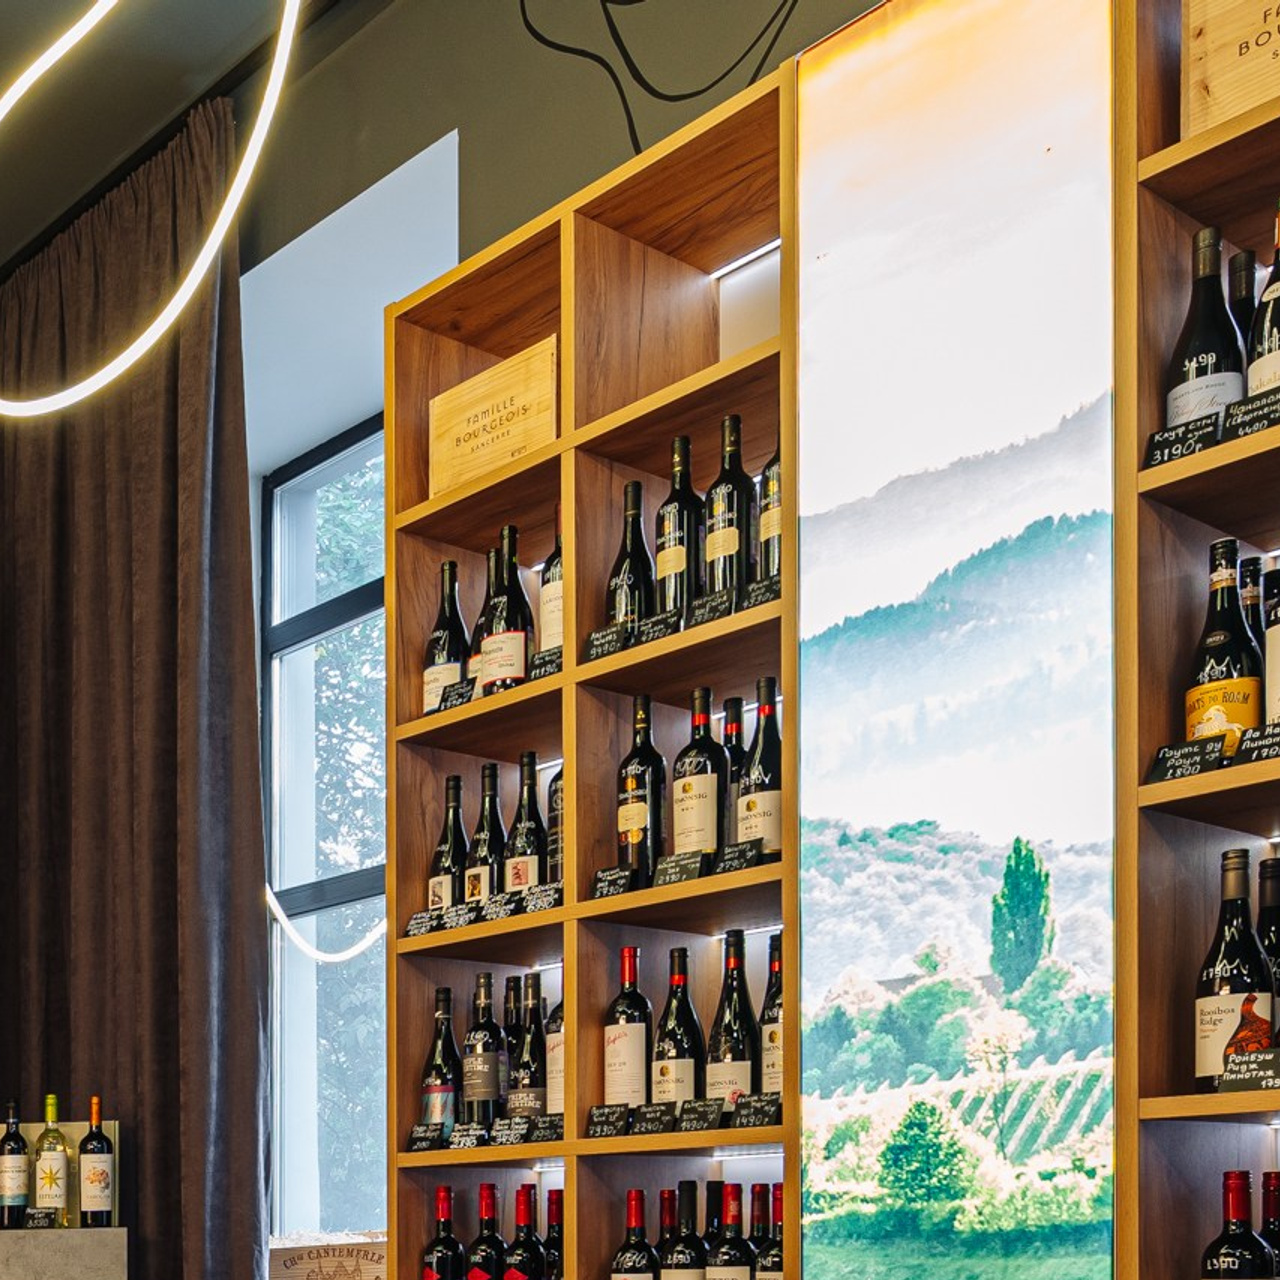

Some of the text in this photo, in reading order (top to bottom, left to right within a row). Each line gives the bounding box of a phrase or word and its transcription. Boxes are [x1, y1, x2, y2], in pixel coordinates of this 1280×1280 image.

[466, 396, 516, 428] FAMILLE
[455, 404, 528, 447] BOURGEOIS
[1222, 691, 1252, 706] ROAM
[1199, 1006, 1236, 1018] Rooibos
